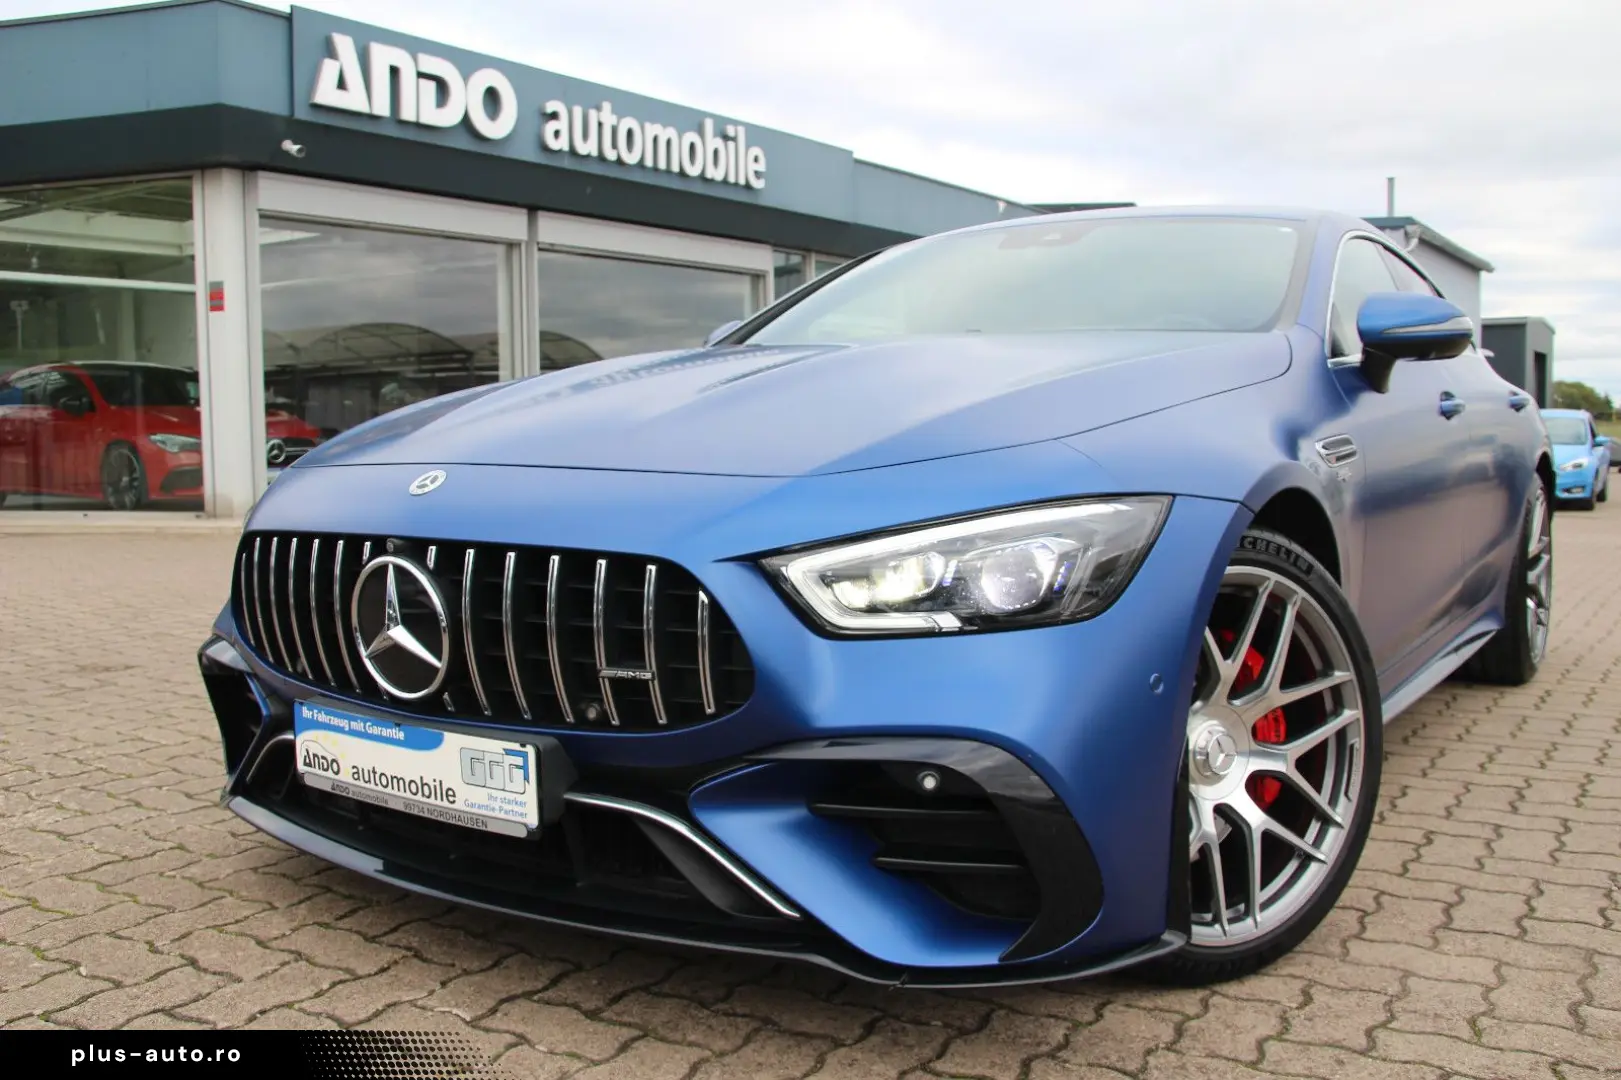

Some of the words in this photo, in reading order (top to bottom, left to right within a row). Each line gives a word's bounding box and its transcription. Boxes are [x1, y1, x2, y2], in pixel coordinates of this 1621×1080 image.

[539, 99, 767, 191] automobile
[302, 706, 313, 719] Ihr
[313, 709, 349, 731] Fahrzeug
[350, 719, 365, 732] mit
[365, 722, 405, 740] Garantie
[351, 765, 457, 805] automobile
[351, 790, 389, 805] automobile
[487, 792, 498, 802] Ihr
[499, 796, 527, 808] starker
[402, 801, 426, 814] 99734
[426, 807, 488, 829] NORDHAUSEN
